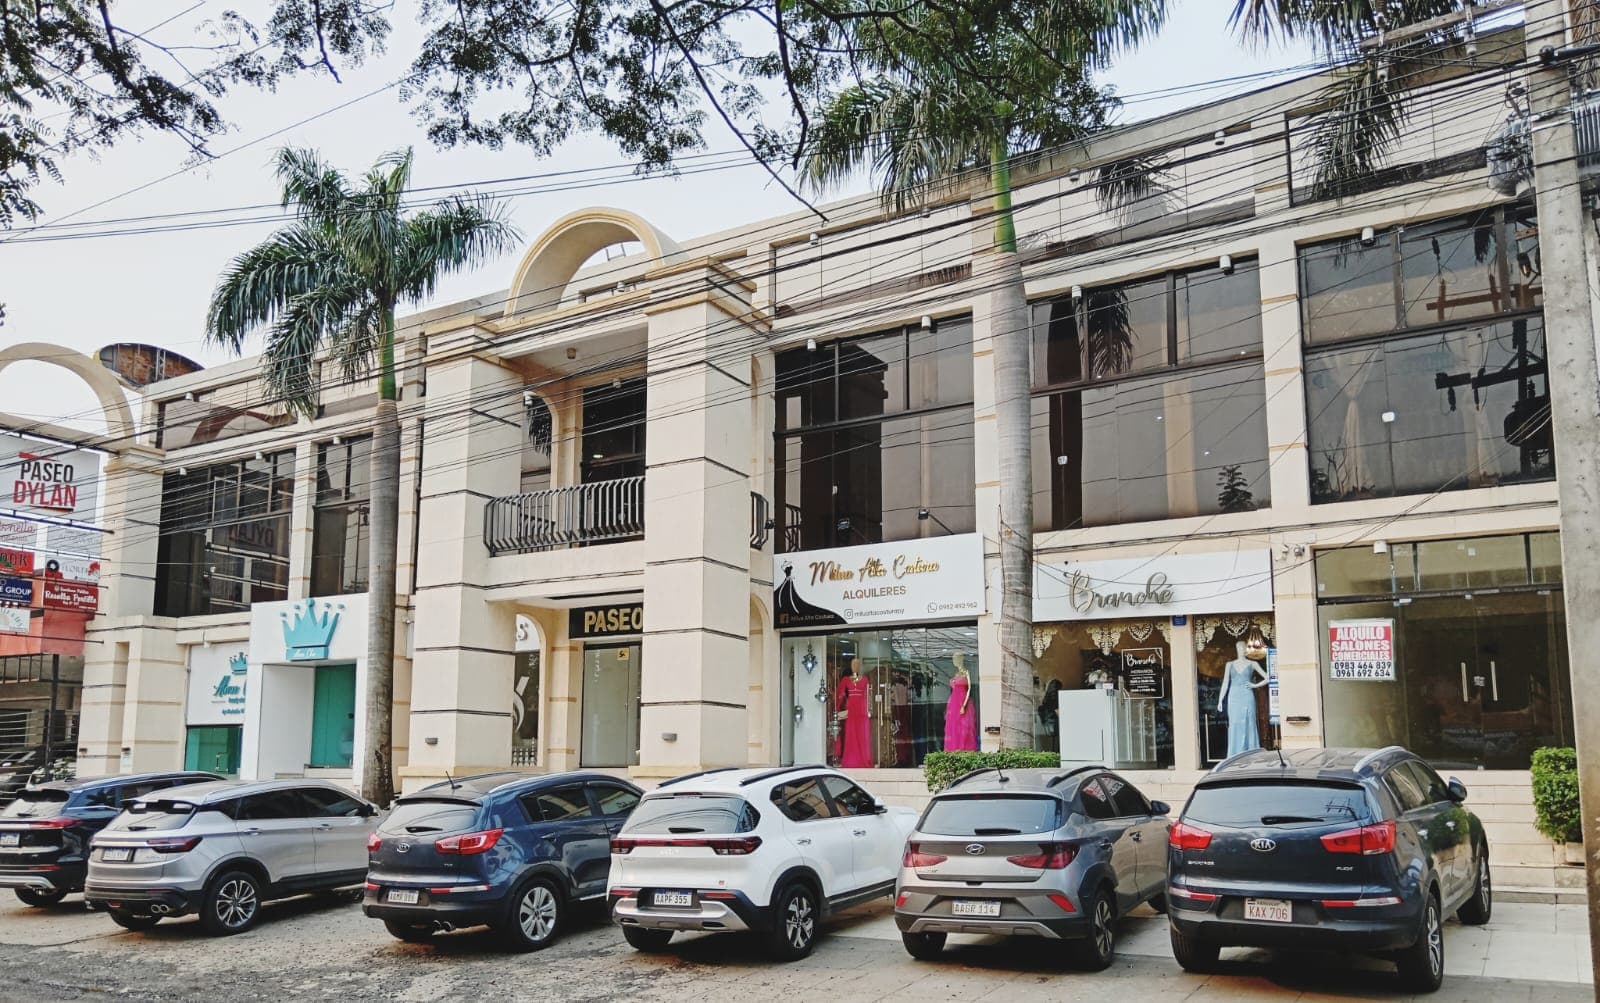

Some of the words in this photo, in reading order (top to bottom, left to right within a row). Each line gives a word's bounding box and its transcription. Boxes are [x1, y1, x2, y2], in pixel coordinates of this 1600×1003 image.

[20, 461, 74, 483] PASEO
[13, 480, 77, 507] DYLAN
[5, 586, 32, 596] GROUP
[843, 585, 907, 600] ALQUILERES
[584, 607, 643, 633] PASEO
[1336, 626, 1385, 641] ALQUILO
[1331, 640, 1390, 651] SALONES
[1332, 650, 1390, 661] COMERCIALES
[1334, 662, 1355, 670] 0983
[1357, 662, 1373, 670] 464
[1375, 661, 1392, 670] 839
[1336, 670, 1355, 678] 0961
[1374, 669, 1391, 677] 634
[1248, 905, 1266, 918] KAX
[1269, 906, 1288, 920] 706
